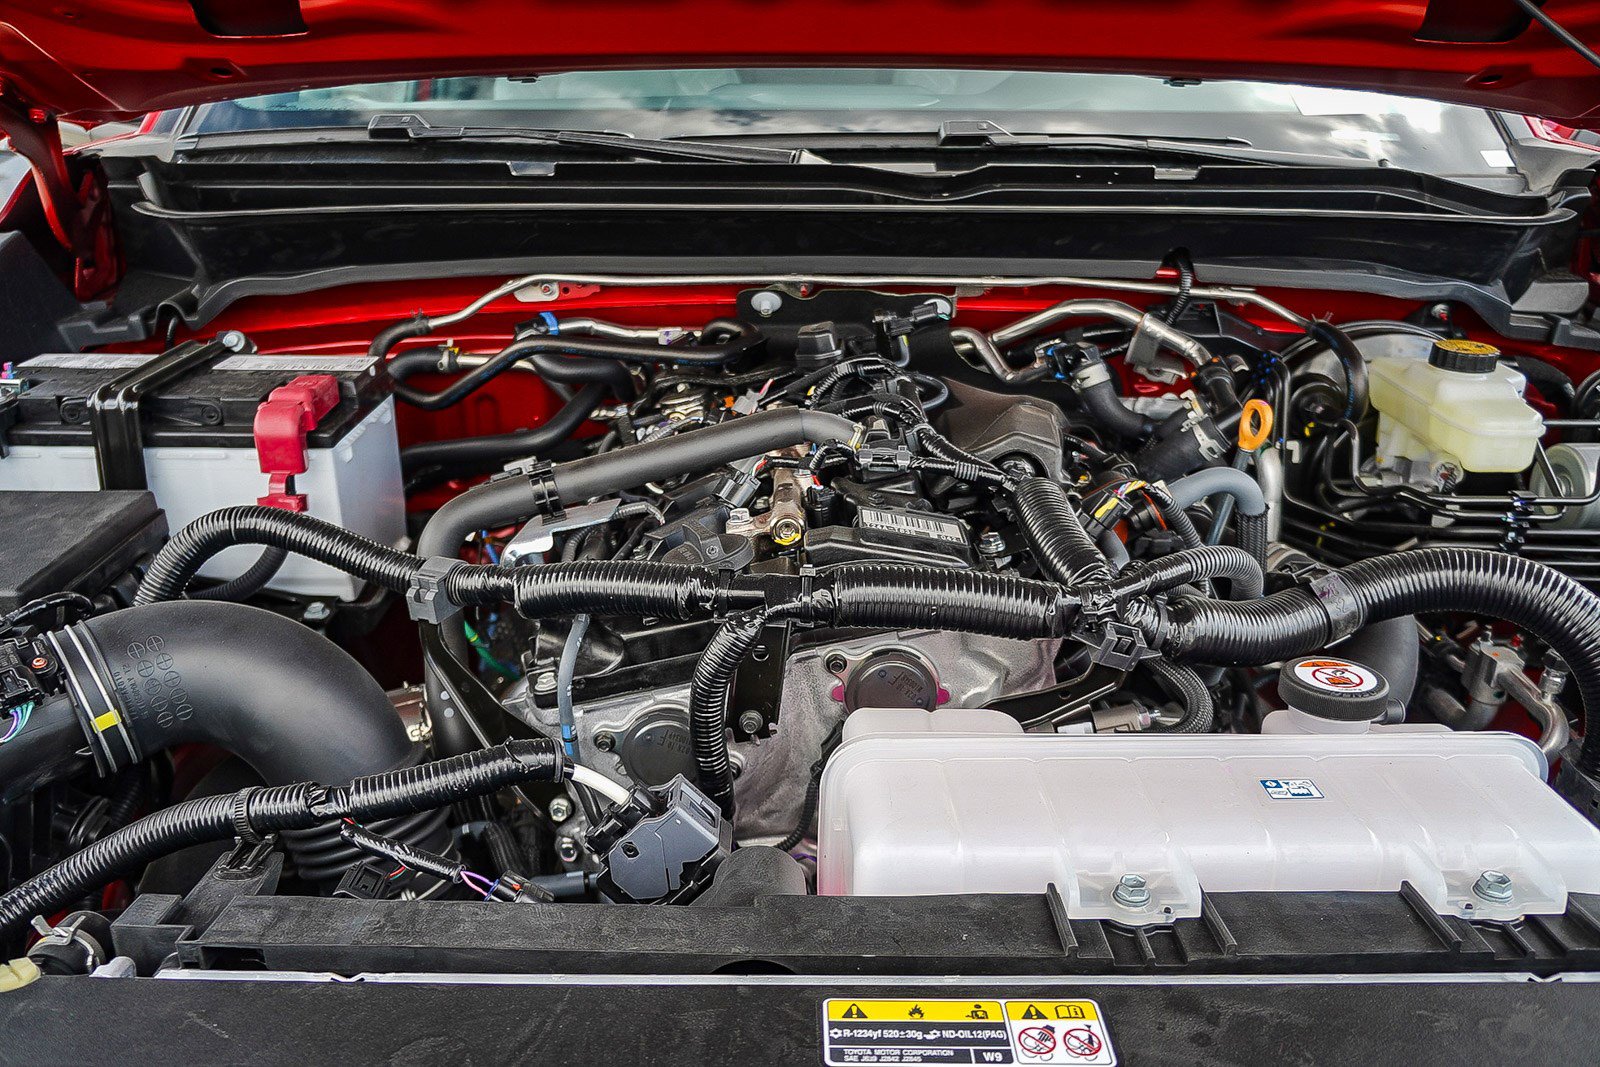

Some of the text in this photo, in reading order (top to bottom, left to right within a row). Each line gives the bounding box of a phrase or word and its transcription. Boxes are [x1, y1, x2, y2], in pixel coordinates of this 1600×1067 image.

[843, 1029, 1007, 1040] R-1234yf 520±30g ND-OIL12(PAG)
[983, 1052, 1004, 1062] W9
